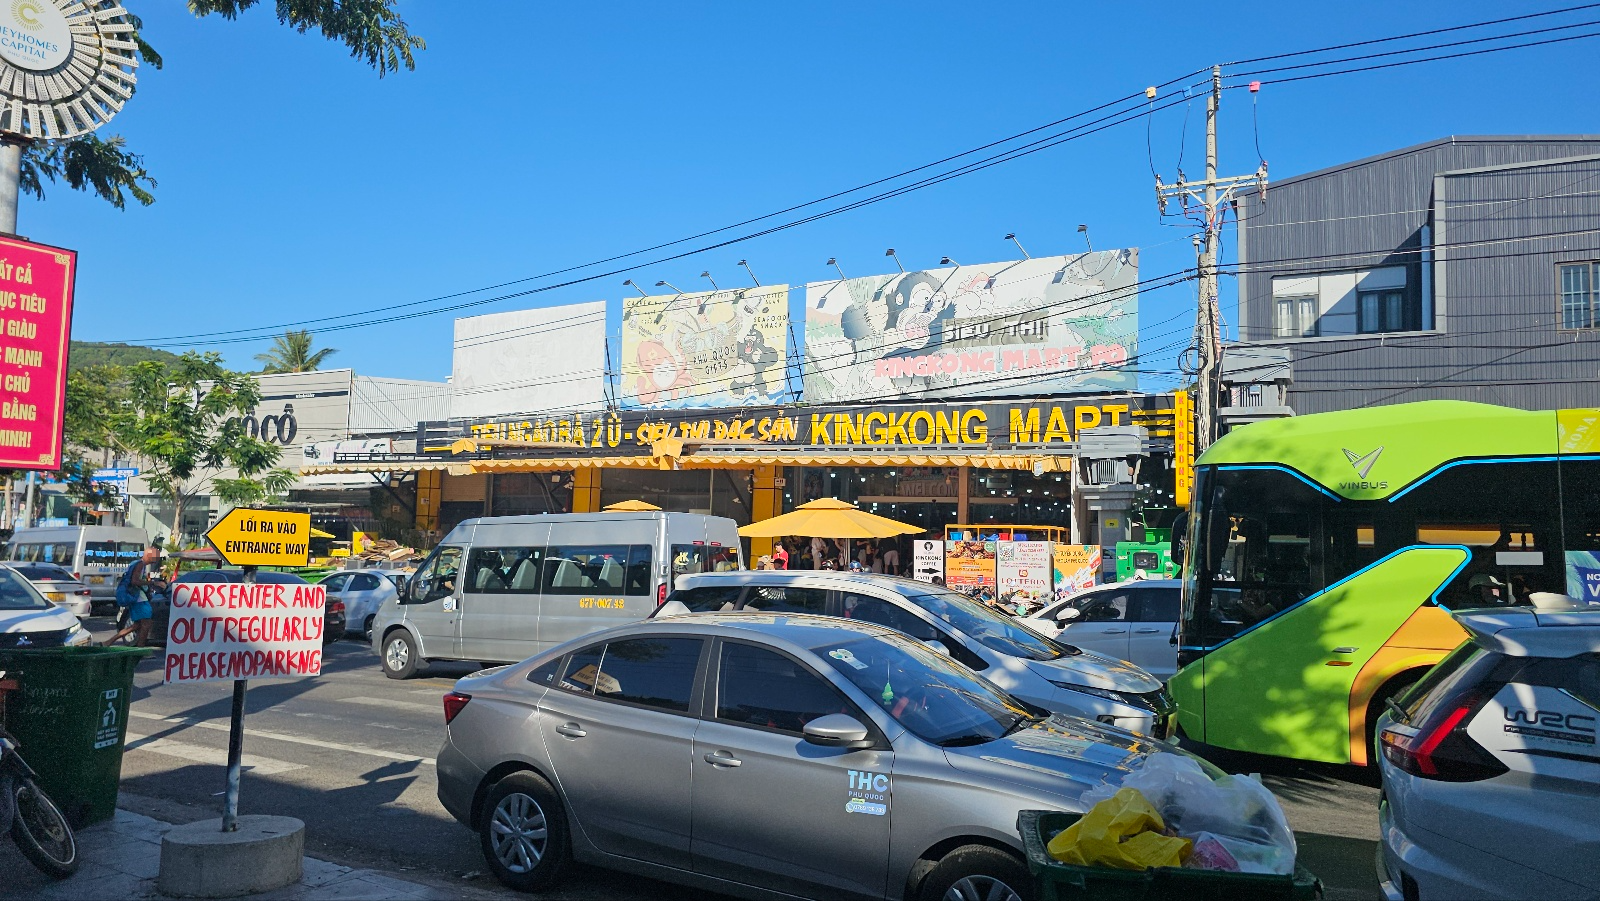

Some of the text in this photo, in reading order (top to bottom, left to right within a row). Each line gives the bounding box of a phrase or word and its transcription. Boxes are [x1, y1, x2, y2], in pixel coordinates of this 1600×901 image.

[0, 26, 58, 52] EYHOMES
[1, 37, 46, 60] CAPITAL
[15, 263, 33, 285] CẢ
[20, 293, 46, 313] TIÊU
[7, 318, 37, 340] GIÀU
[5, 347, 42, 369] MẠNH
[875, 351, 995, 378] KINGKONG
[1003, 346, 1083, 373] MART
[5, 372, 31, 393] CHỦ
[2, 397, 37, 421] BẰNG
[810, 407, 989, 446] KINGKONG
[1178, 395, 1186, 488] KINGKONG
[1339, 481, 1389, 490] VINBUS
[240, 515, 297, 534] LỐI RA VÀO
[225, 540, 306, 555] ENTRANCE WAY
[292, 585, 325, 610] AND
[1504, 706, 1596, 733] WRC
[847, 769, 889, 792] THC
[848, 790, 863, 798] PHU
